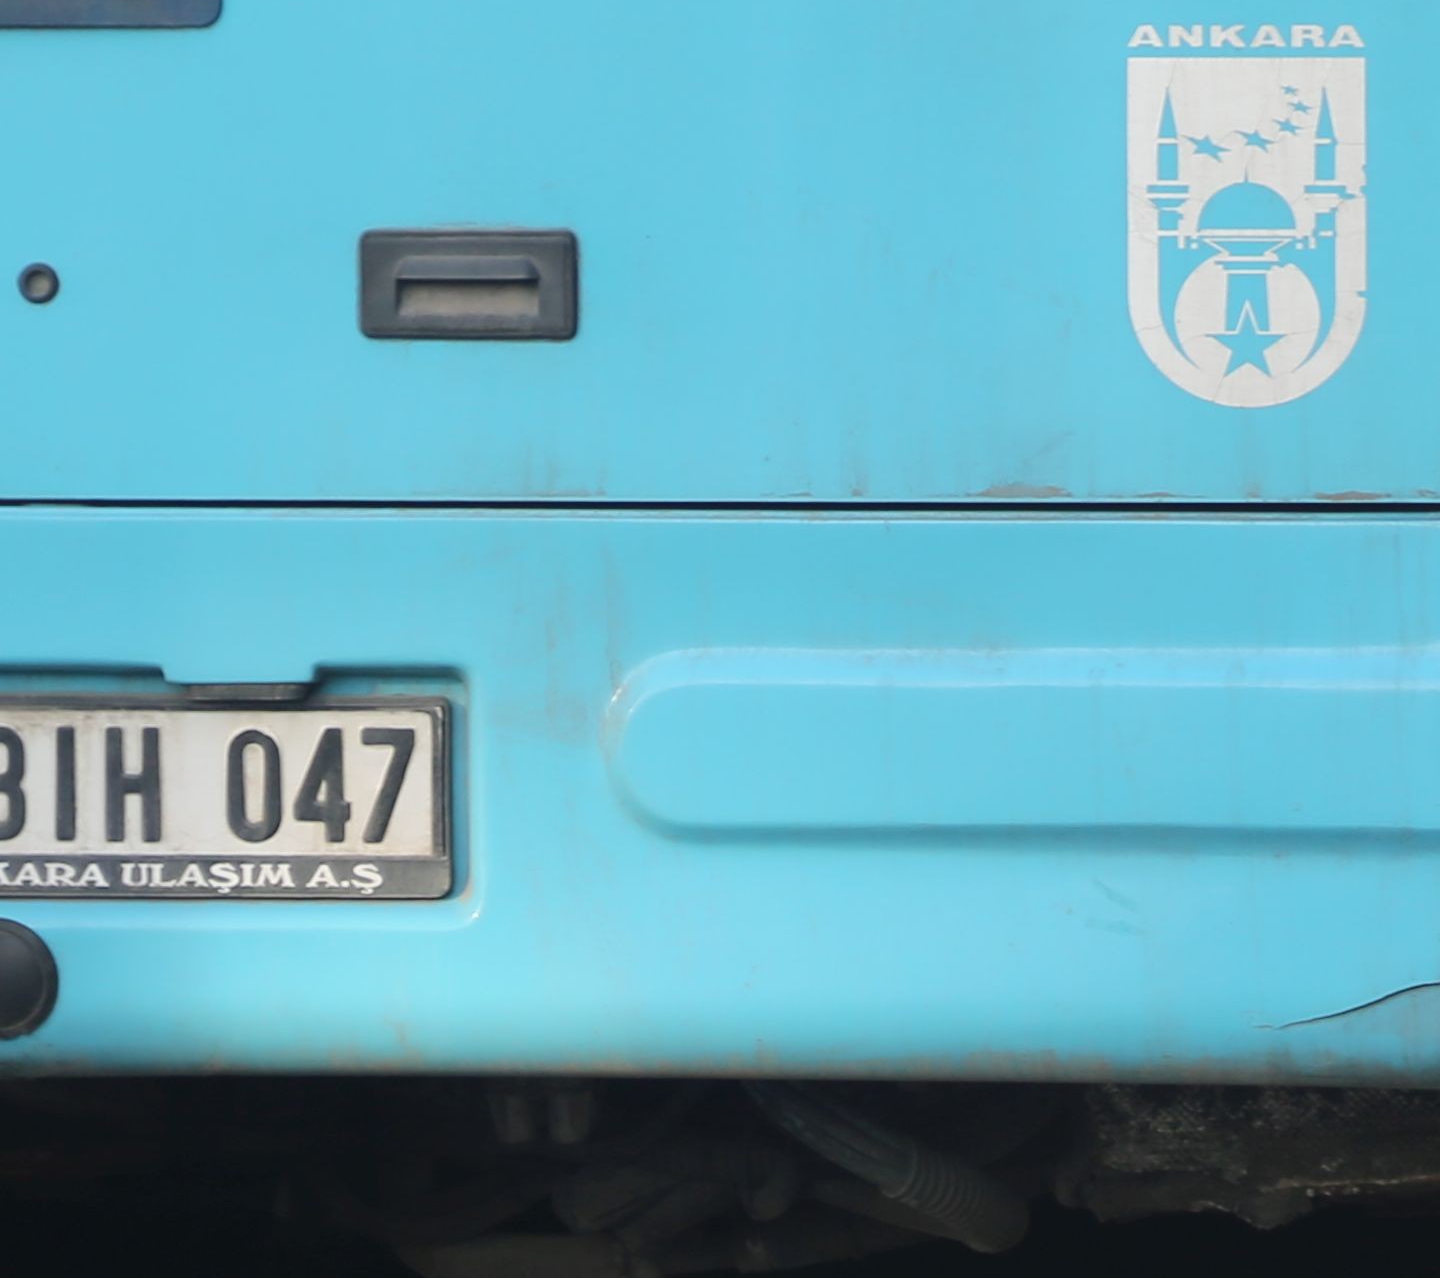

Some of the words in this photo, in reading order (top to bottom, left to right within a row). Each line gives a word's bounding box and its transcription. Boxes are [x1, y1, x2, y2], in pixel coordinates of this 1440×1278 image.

[1127, 24, 1366, 48] ANKARA
[227, 727, 416, 845] 047
[121, 863, 295, 898] ULAŞIM
[307, 863, 384, 898] A.Ş
